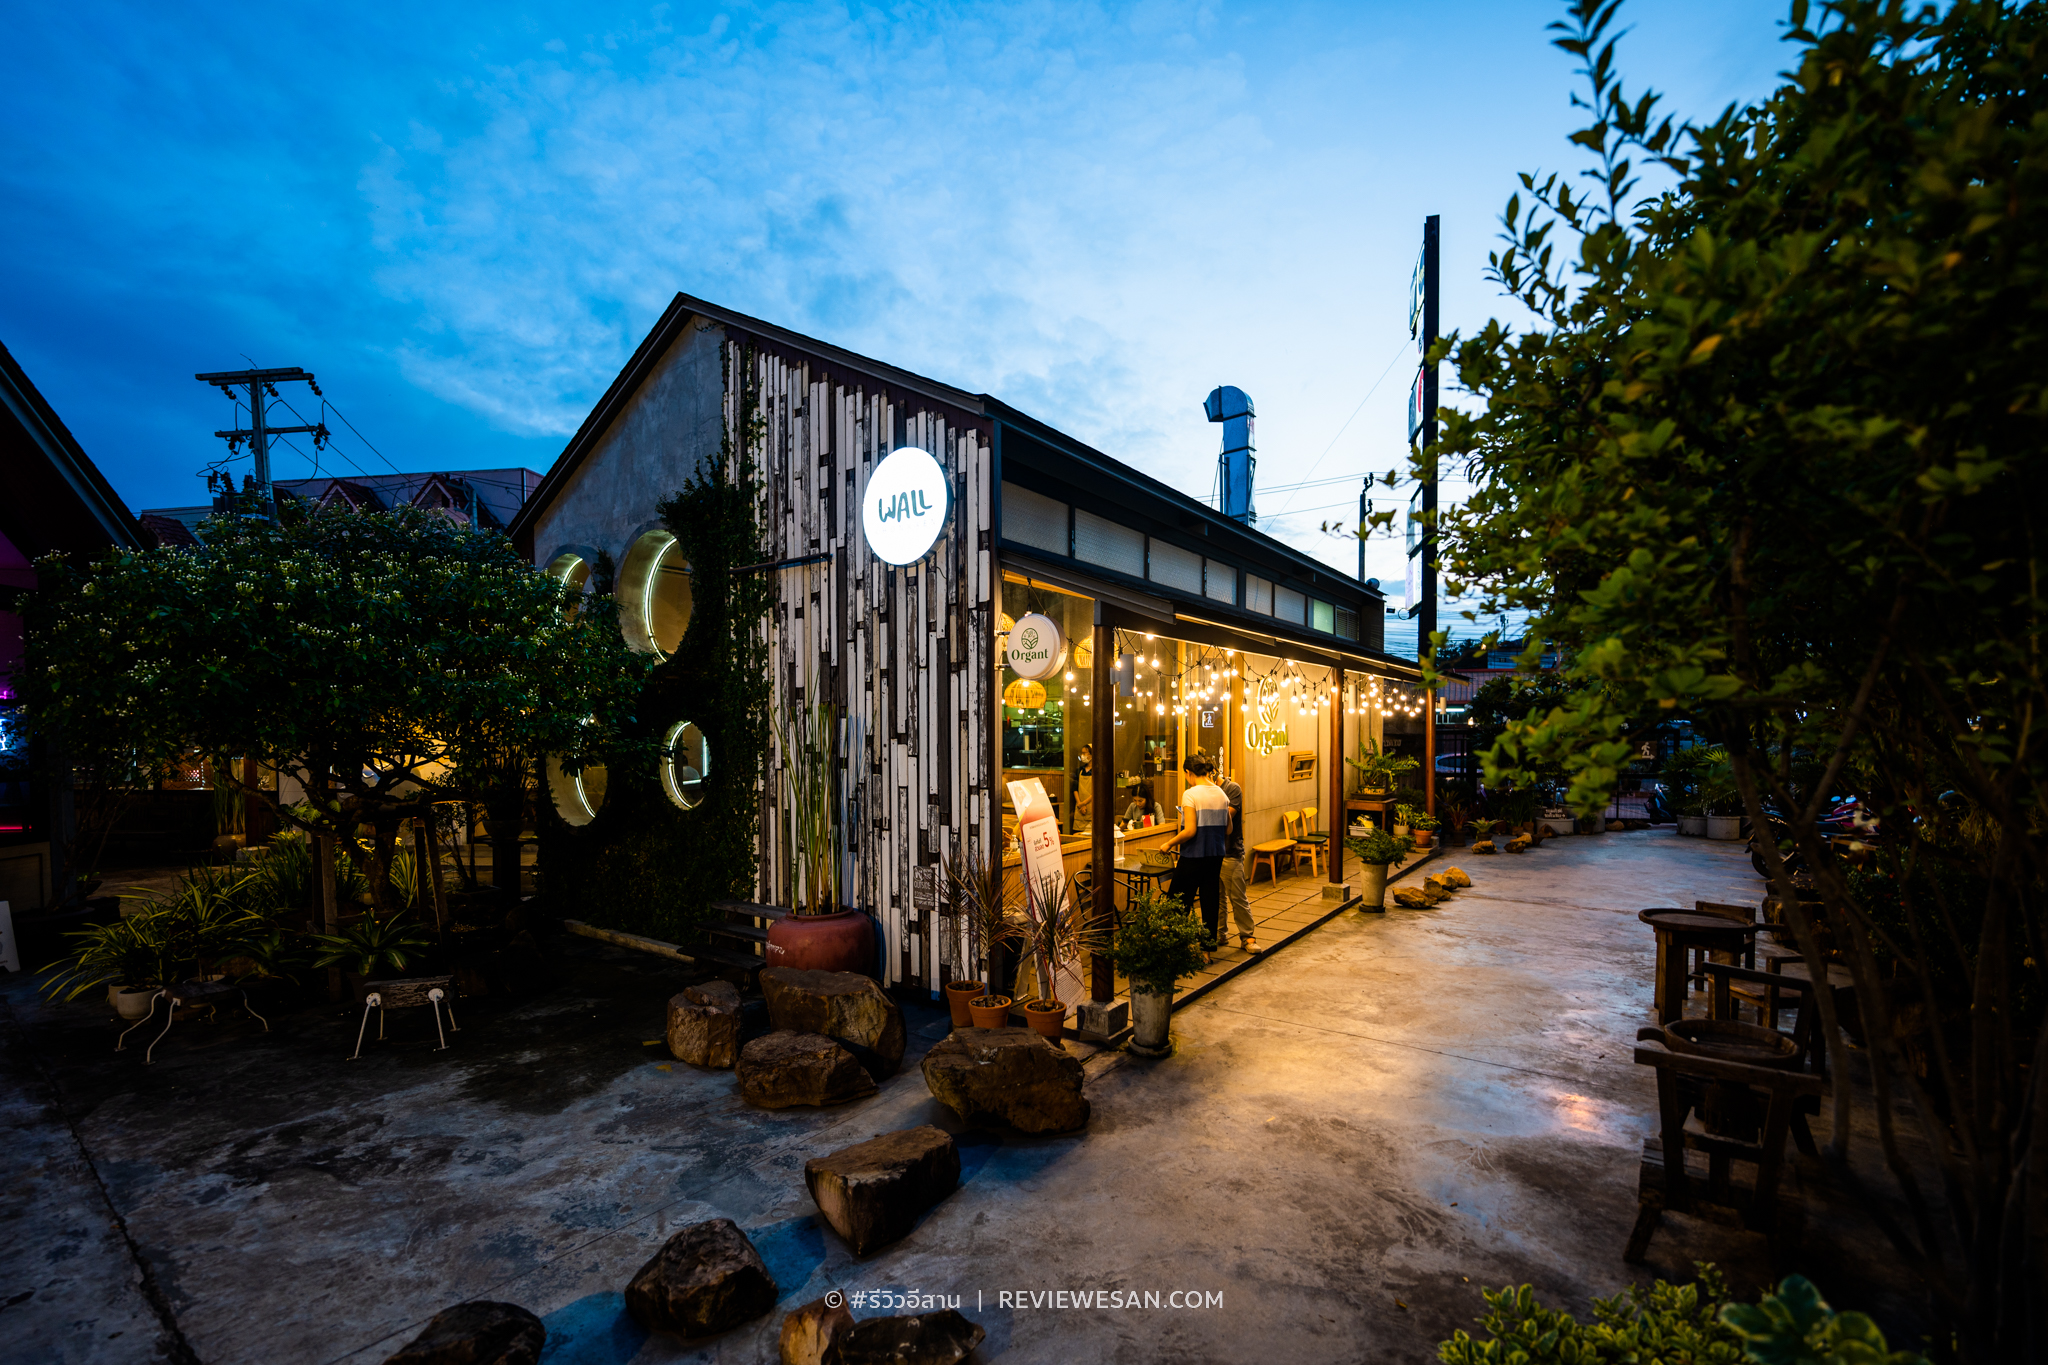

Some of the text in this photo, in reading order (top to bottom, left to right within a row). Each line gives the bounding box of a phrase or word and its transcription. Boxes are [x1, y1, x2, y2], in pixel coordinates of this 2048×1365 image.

[878, 489, 933, 523] WALL
[1011, 648, 1049, 663] Organt
[1247, 721, 1290, 755] Organt
